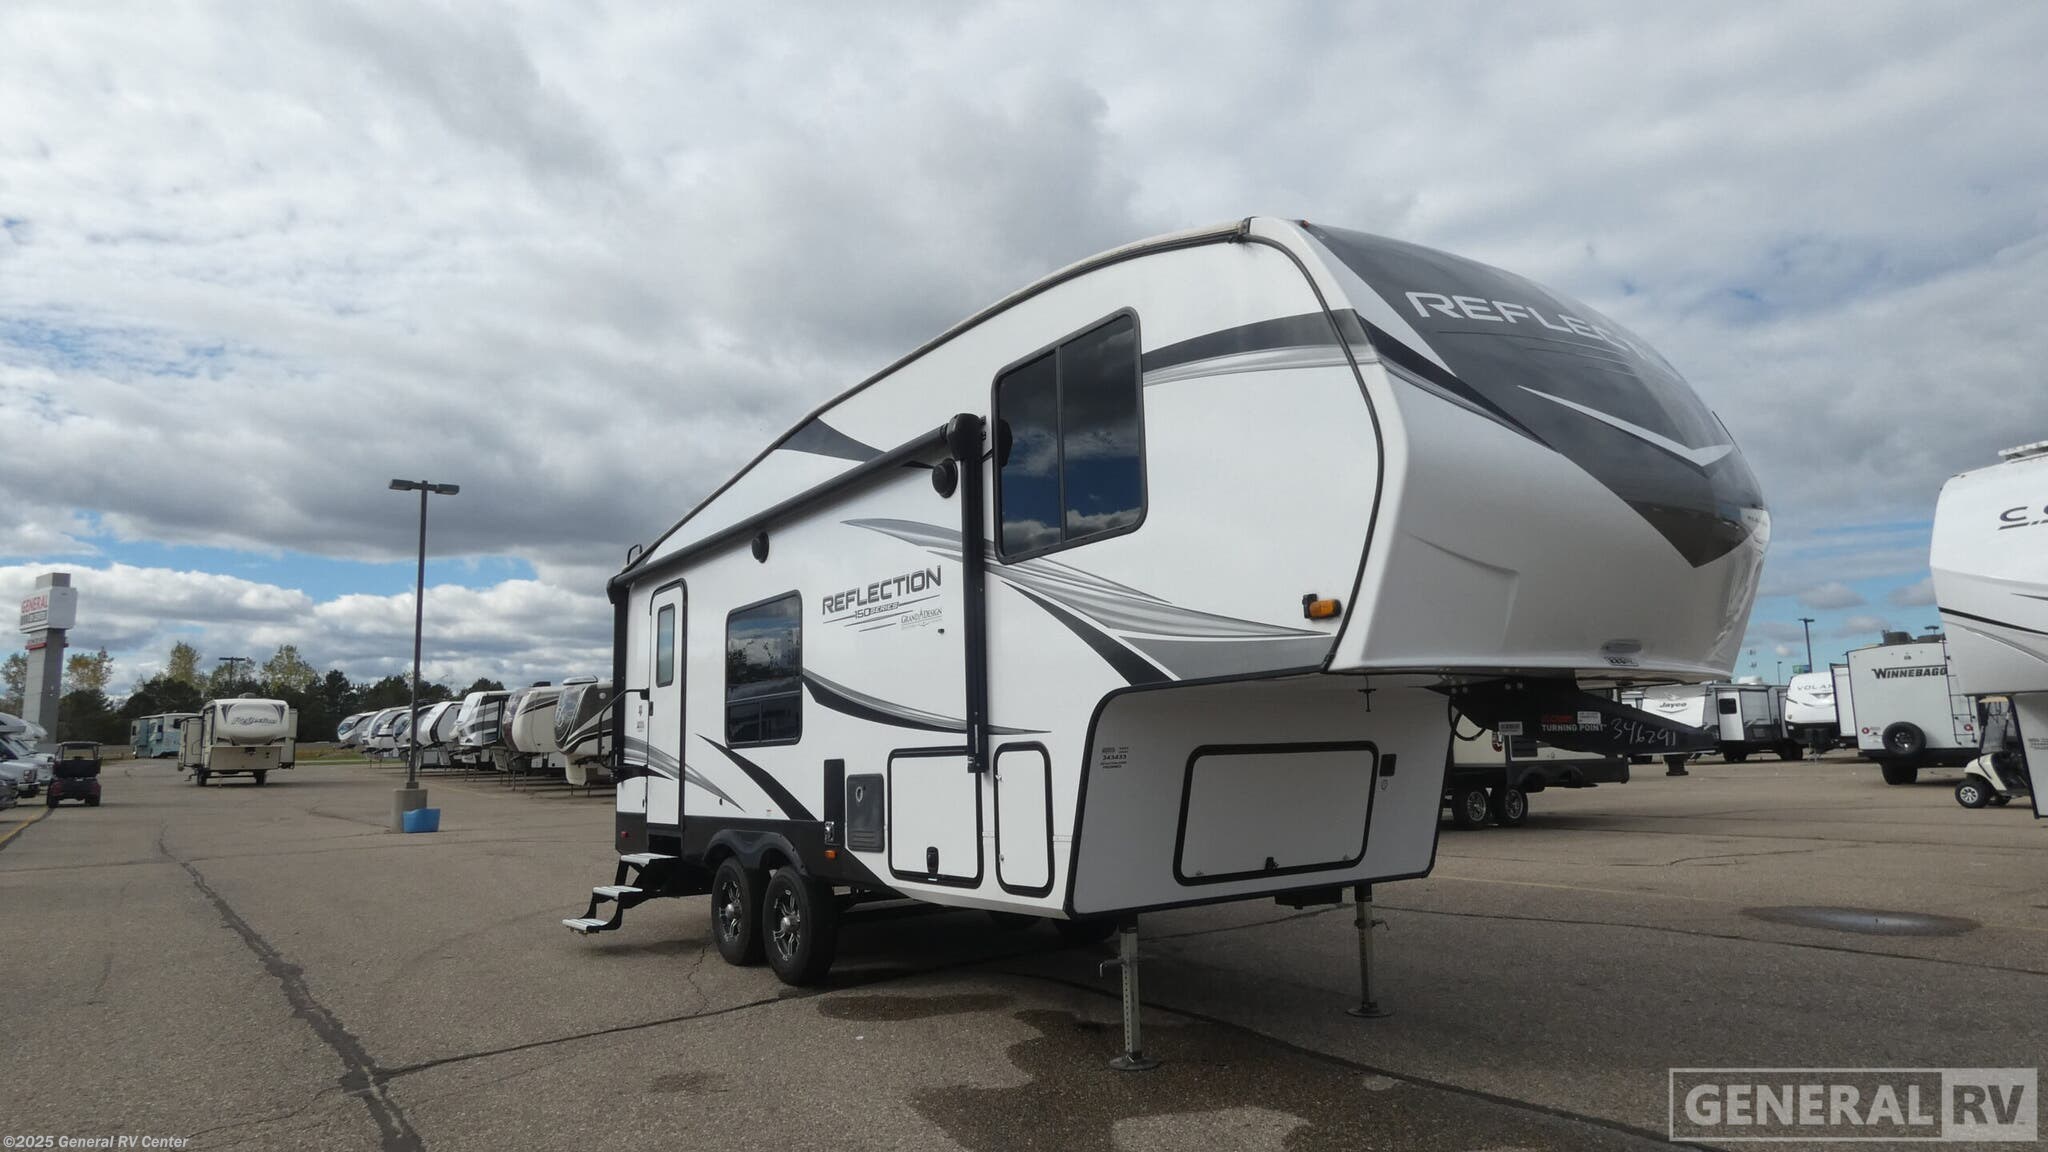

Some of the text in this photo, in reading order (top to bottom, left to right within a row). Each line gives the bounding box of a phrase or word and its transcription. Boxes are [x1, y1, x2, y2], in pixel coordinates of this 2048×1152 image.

[822, 564, 942, 615] REFLECTION
[1872, 666, 1948, 679] WINNEBAGO
[1541, 723, 1605, 732] TURNING POINT
[1610, 717, 1677, 746] 346291
